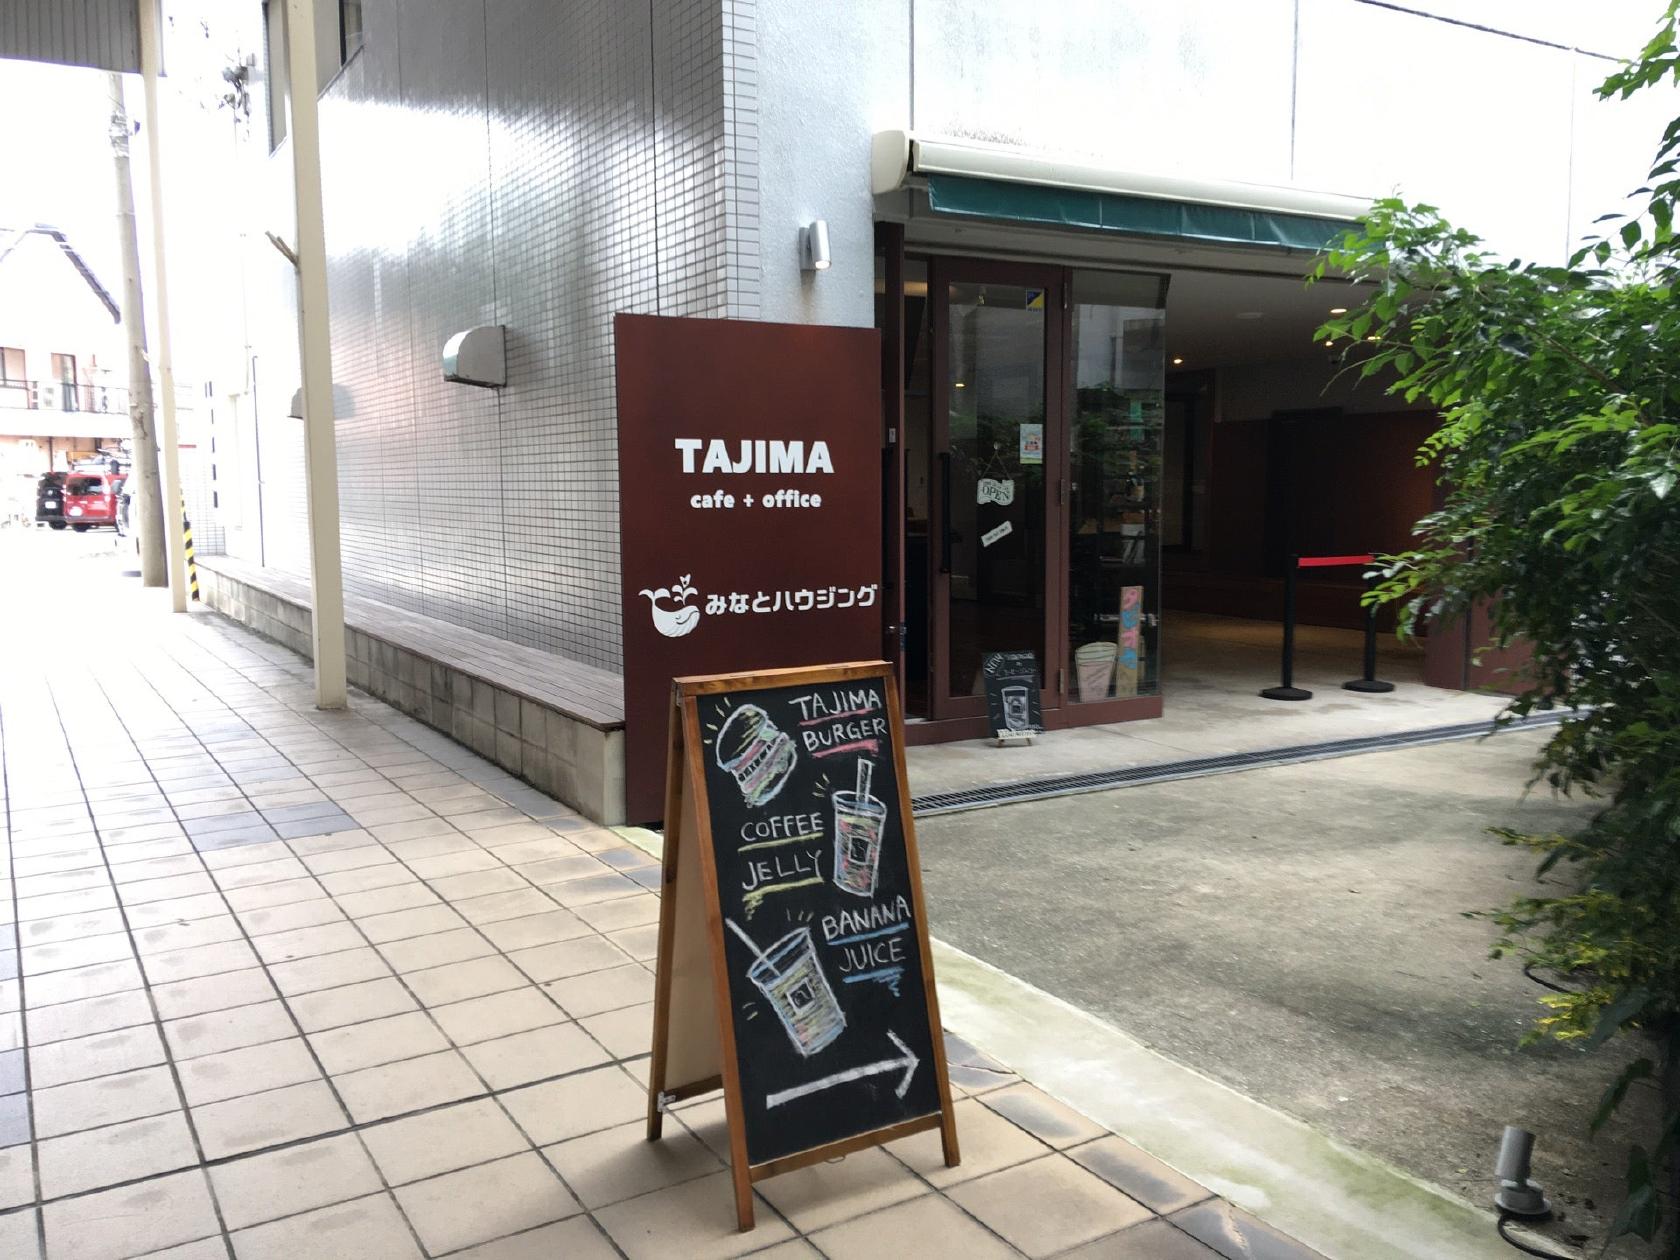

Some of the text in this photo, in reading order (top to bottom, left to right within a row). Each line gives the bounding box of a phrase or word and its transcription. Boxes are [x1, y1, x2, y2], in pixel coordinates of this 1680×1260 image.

[674, 438, 835, 474] TAJIMA
[690, 489, 822, 509] cafe + office
[982, 485, 1010, 502] OPEN
[705, 583, 878, 615] みなとハウジング
[789, 689, 882, 721] TAJIMA
[802, 717, 887, 752] BURGER
[740, 812, 825, 842] COFFEE
[742, 849, 823, 891] JELLY
[822, 895, 912, 940] BANANA
[839, 937, 907, 973] JUICE
